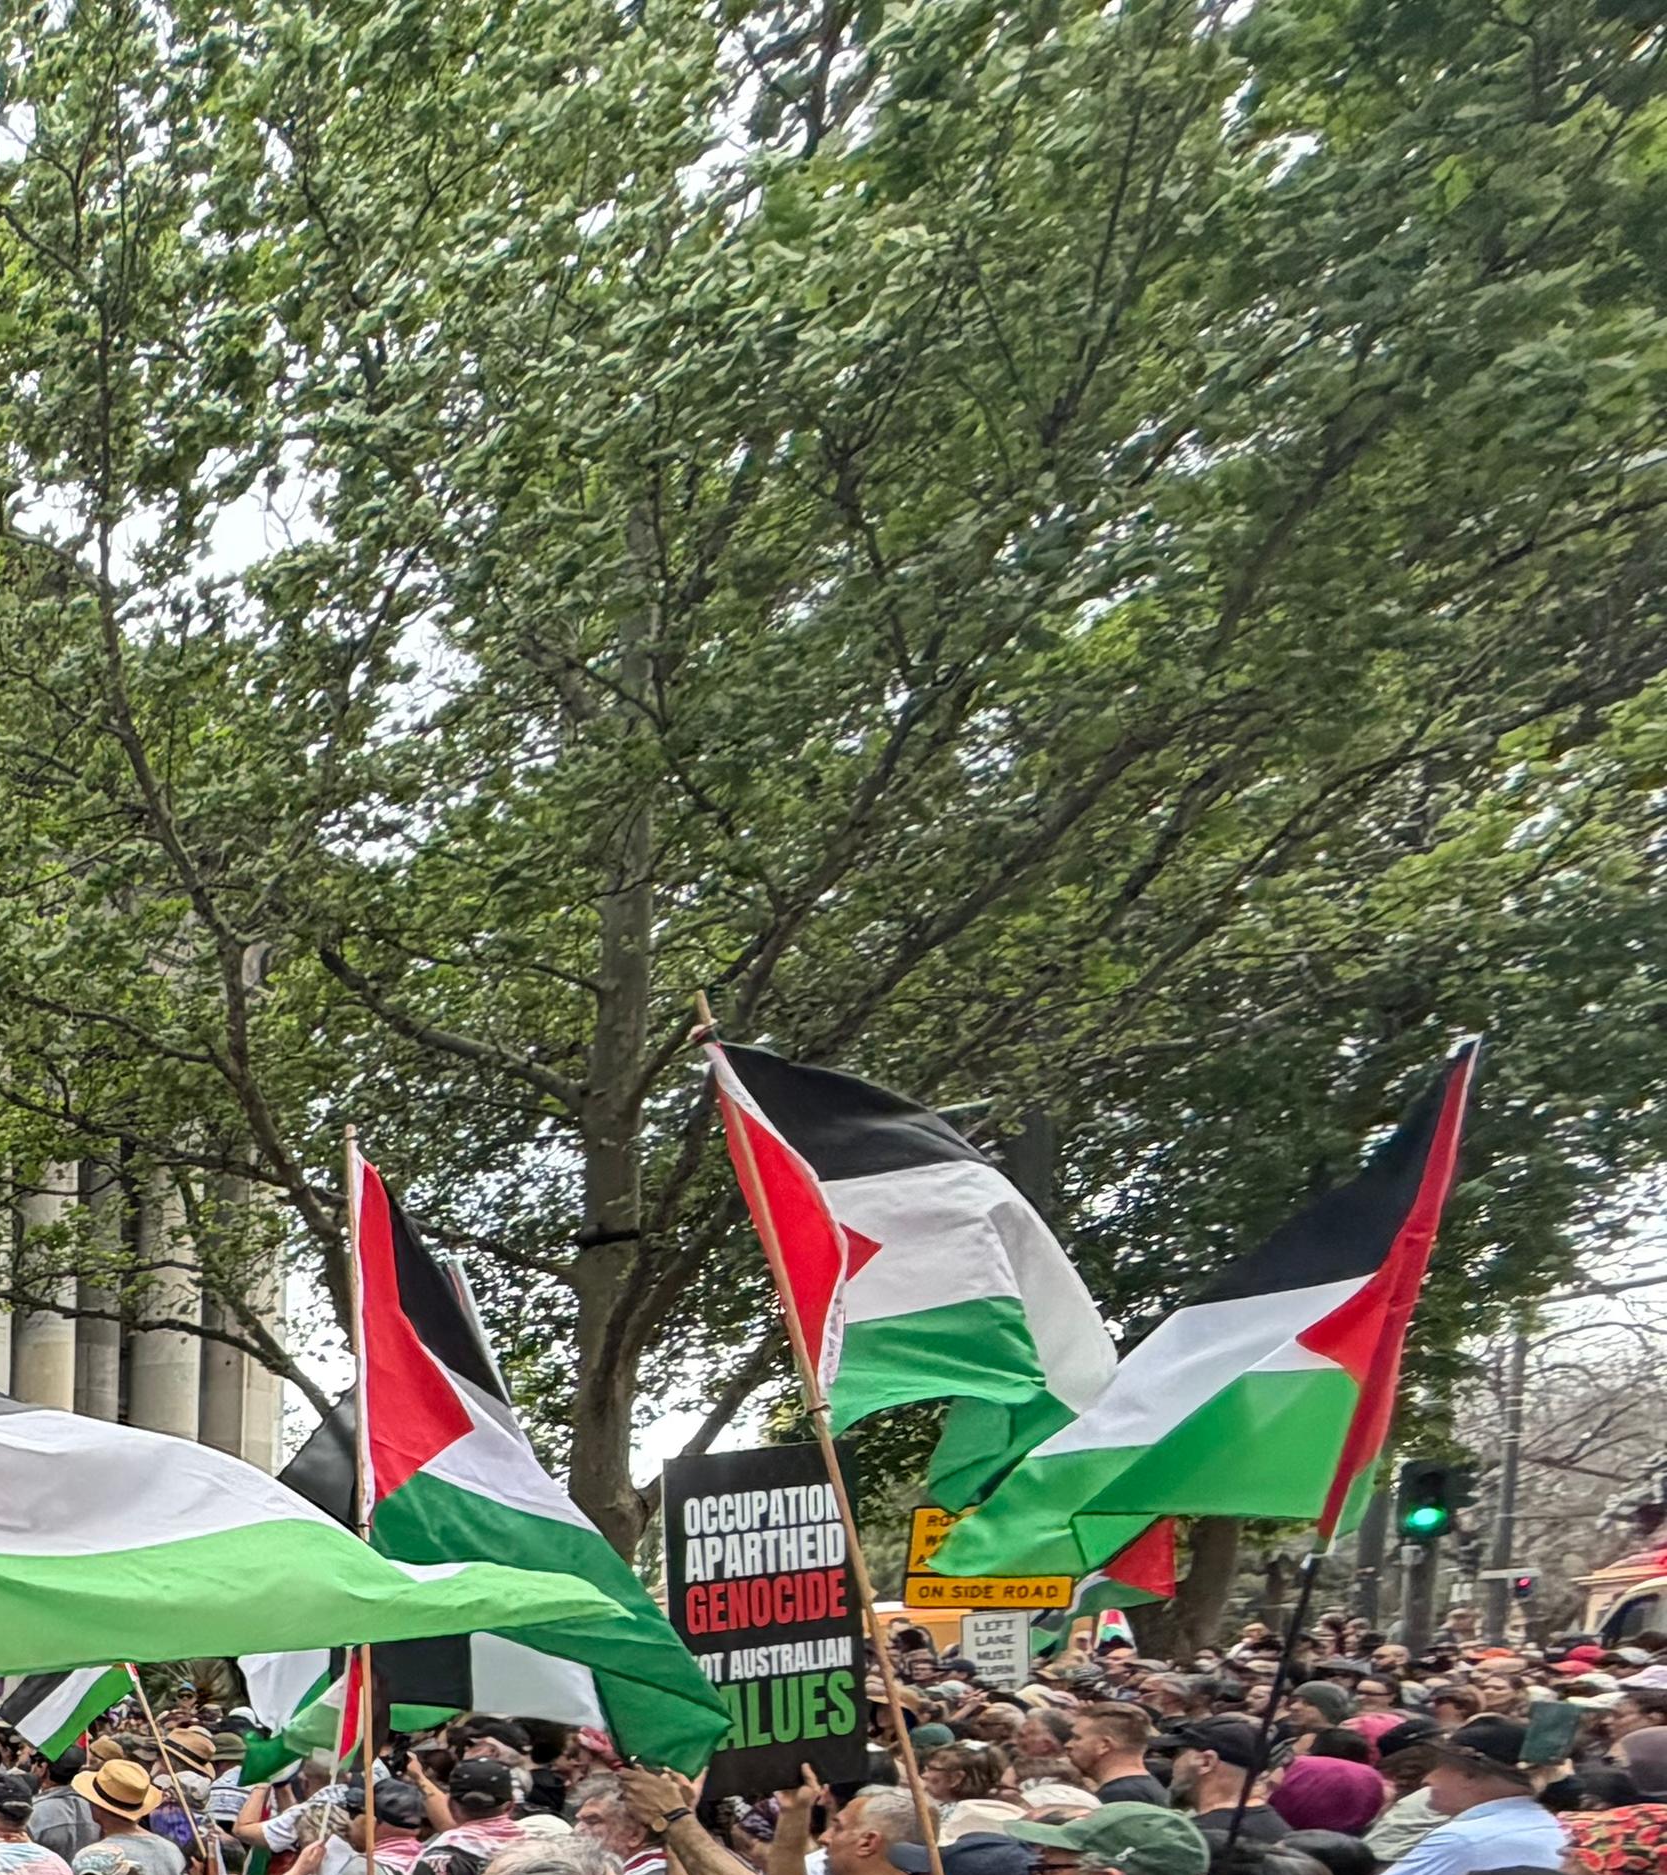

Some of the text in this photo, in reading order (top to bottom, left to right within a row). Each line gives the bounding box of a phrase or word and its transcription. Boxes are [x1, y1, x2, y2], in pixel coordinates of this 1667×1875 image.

[684, 1484, 842, 1537] OCCUPATION
[685, 1522, 846, 1584] APARTHEID
[685, 1568, 848, 1635] GENOCIDE
[918, 1586, 1059, 1599] ON SIDE ROAD
[973, 1620, 1014, 1632] LEFT
[975, 1634, 1015, 1647] LANE
[729, 1636, 852, 1682] AUSTRALIAN
[976, 1649, 1013, 1661] MUST
[717, 1670, 857, 1750] ALUES
